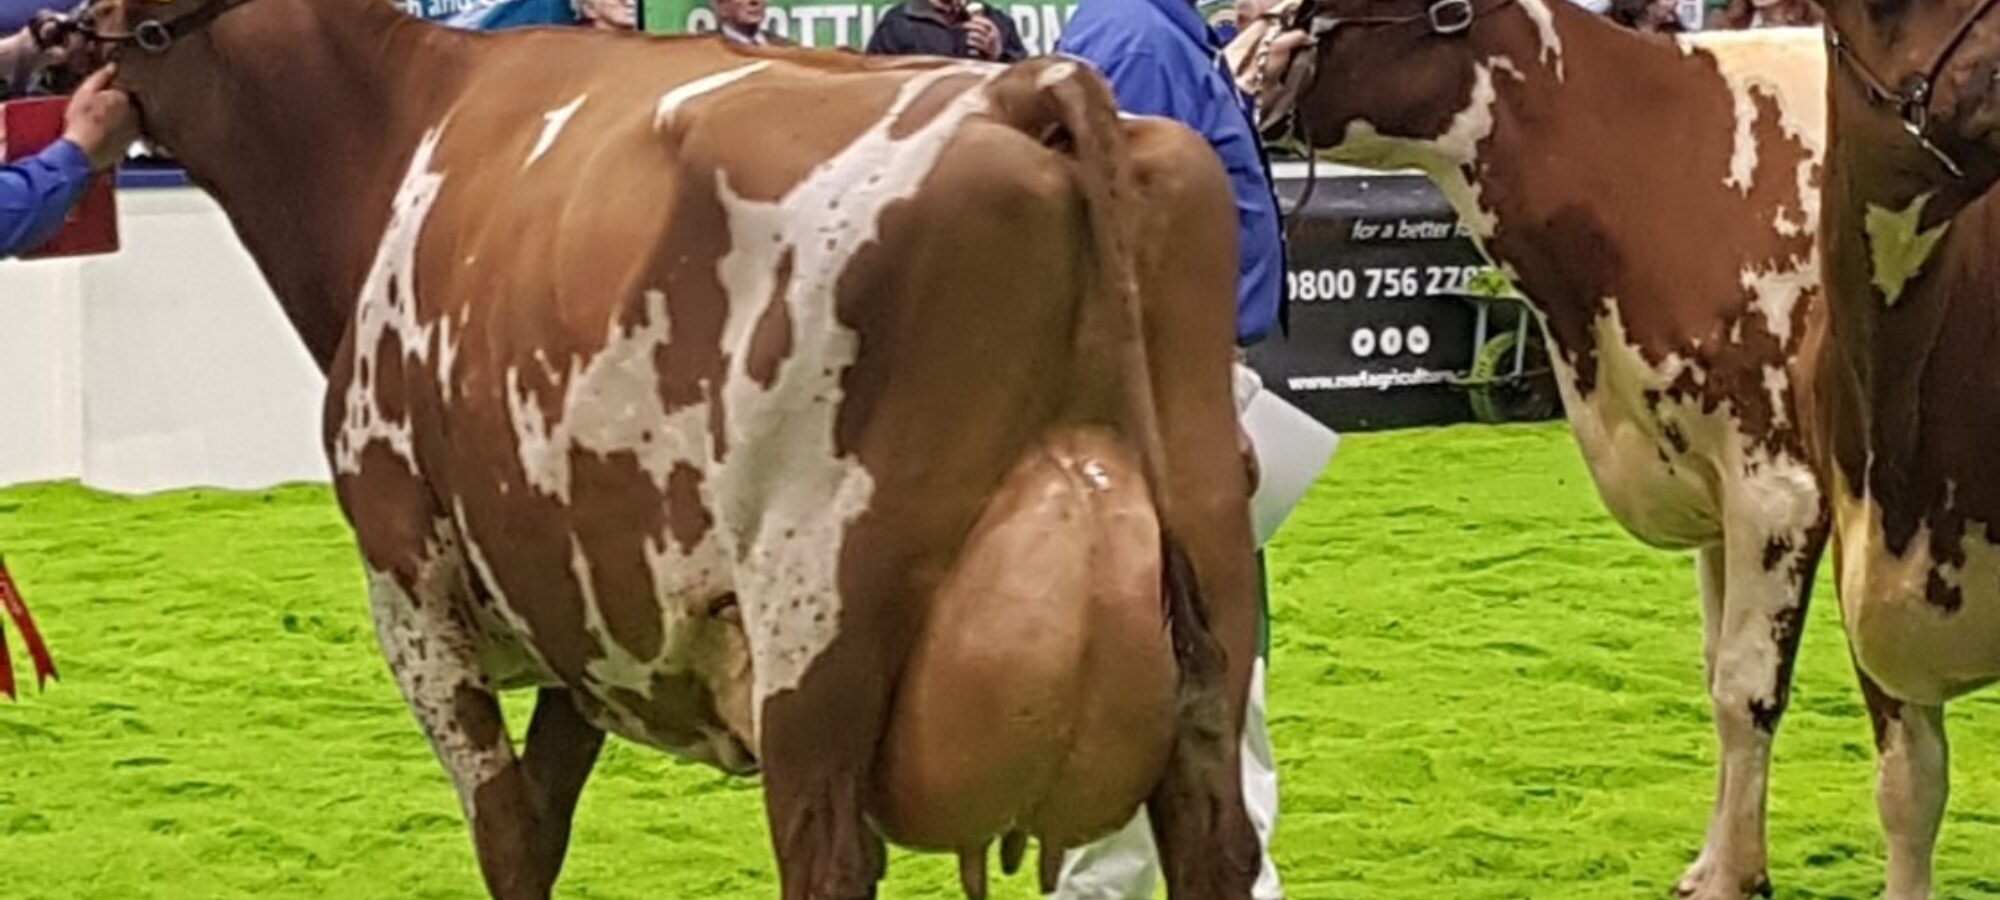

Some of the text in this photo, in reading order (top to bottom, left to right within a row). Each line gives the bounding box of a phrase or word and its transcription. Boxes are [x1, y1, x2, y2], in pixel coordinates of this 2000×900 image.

[1381, 223, 1394, 239] a
[1397, 217, 1451, 239] better
[1363, 266, 1418, 299] 756
